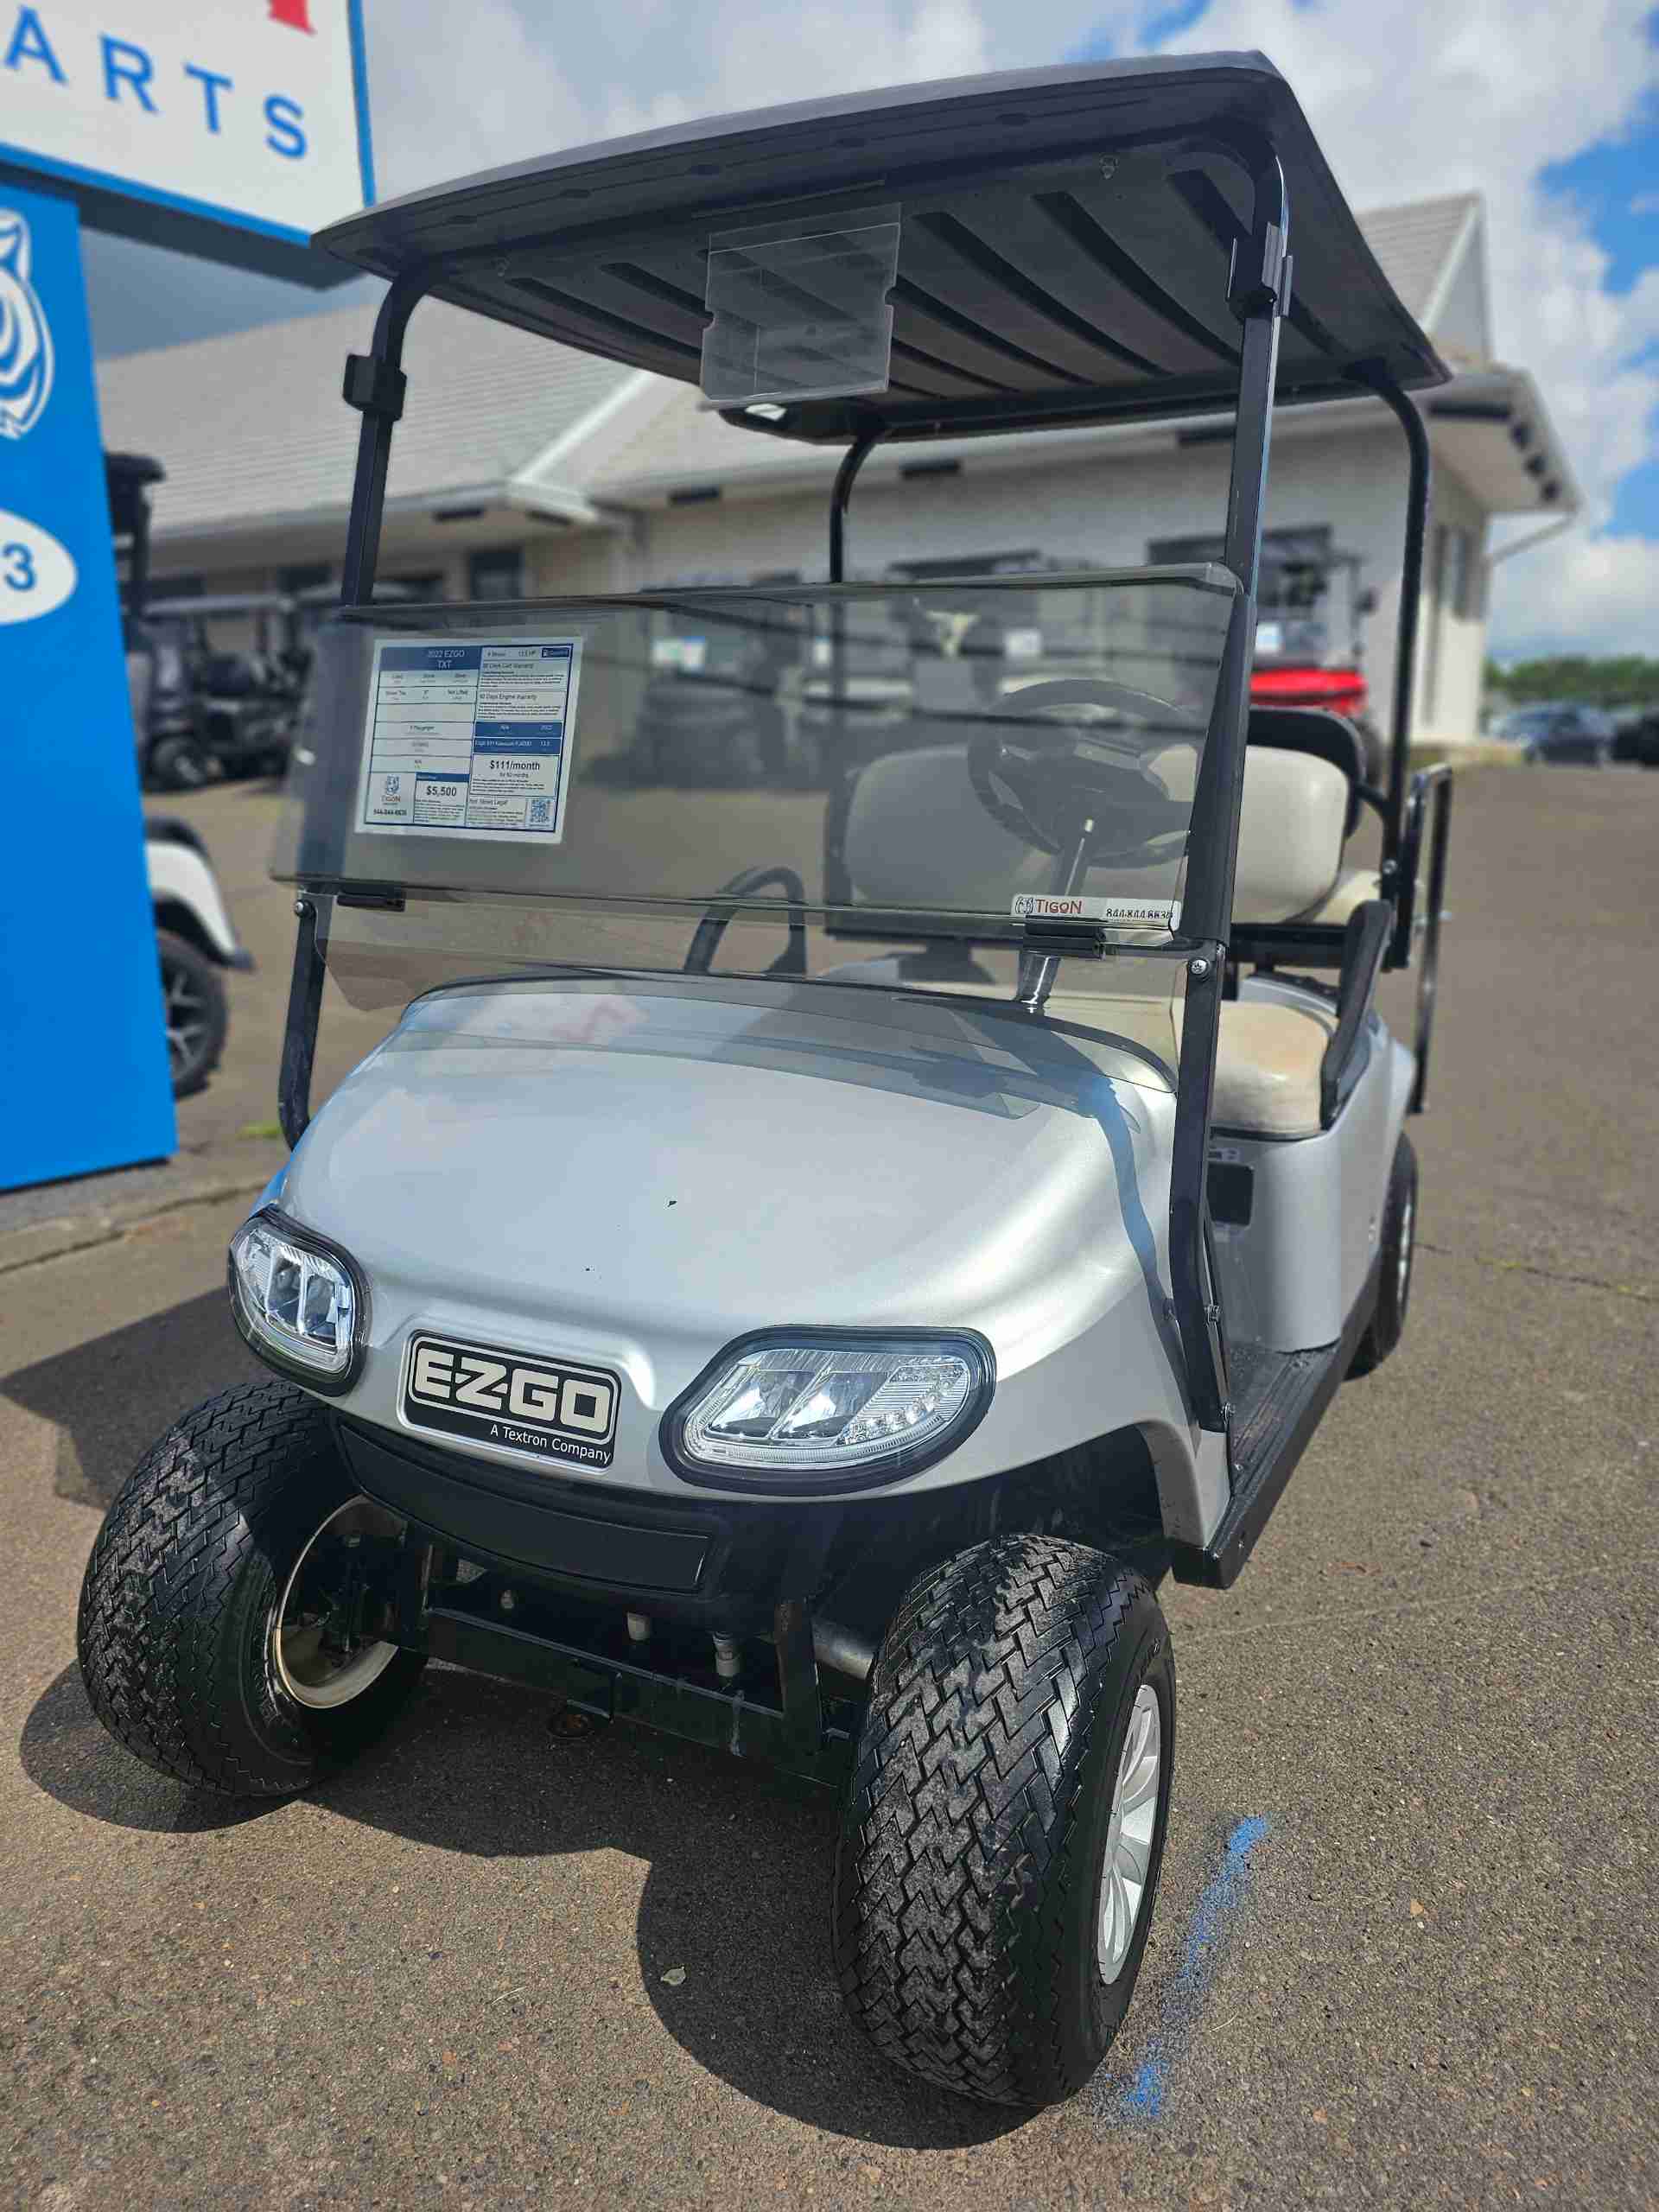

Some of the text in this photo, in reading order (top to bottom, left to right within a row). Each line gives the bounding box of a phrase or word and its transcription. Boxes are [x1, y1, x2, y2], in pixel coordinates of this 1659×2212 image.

[3, 4, 308, 159] ARTS
[444, 649, 465, 658] EZGO
[438, 659, 452, 669] TXT
[490, 760, 540, 770] $111/month
[426, 785, 457, 797] $5,500
[1034, 899, 1082, 914] TIGON
[490, 1423, 612, 1464] A Textron Company
